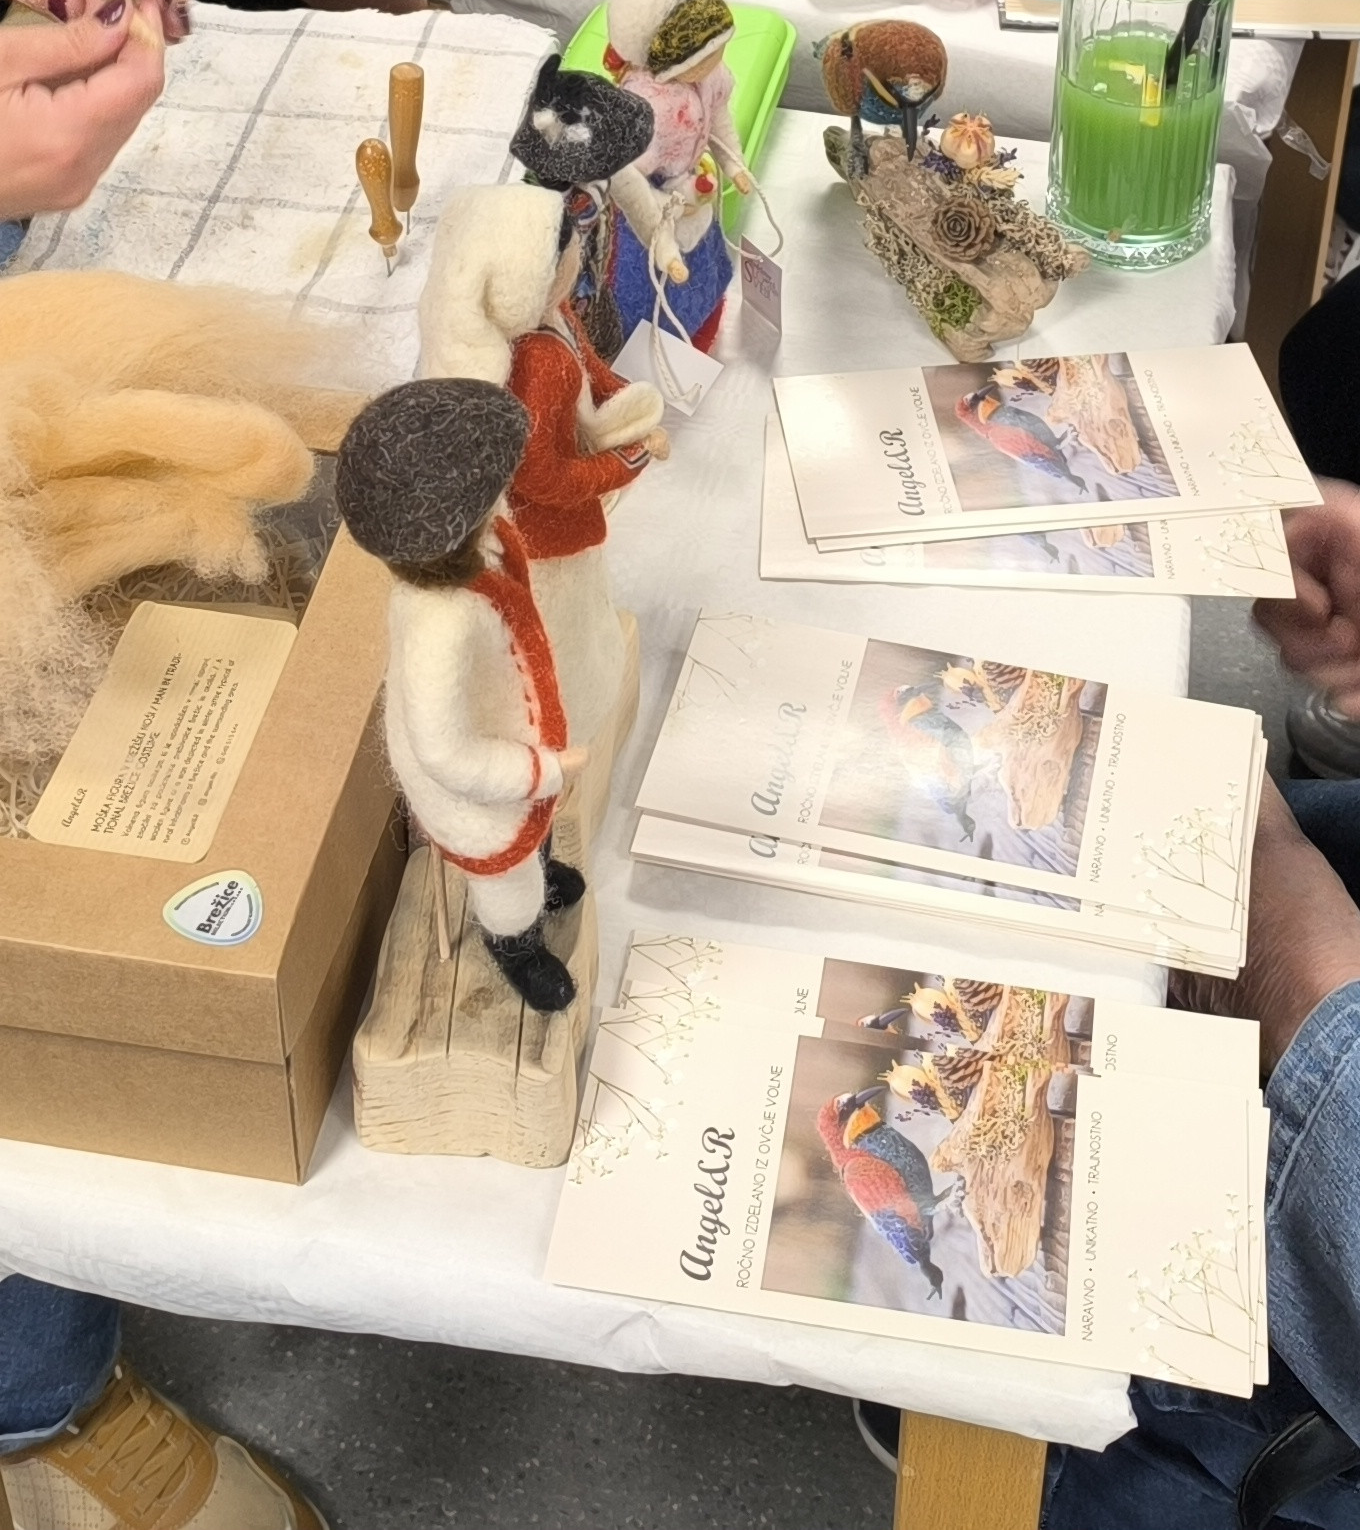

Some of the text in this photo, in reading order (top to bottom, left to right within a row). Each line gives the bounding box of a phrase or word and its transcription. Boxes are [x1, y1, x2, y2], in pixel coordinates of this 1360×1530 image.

[1108, 712, 1127, 768] TRAJNOSTNO
[1098, 779, 1116, 824] UNIKATNO
[1090, 834, 1107, 884] NARAVNO
[196, 880, 239, 934] Brežice
[736, 1064, 783, 1289] ROČNO IZDELANO IZ OVČJE VOLNE
[1081, 1110, 1103, 1342] NARAVNO UNIKATNO TRAJNOSTNO
